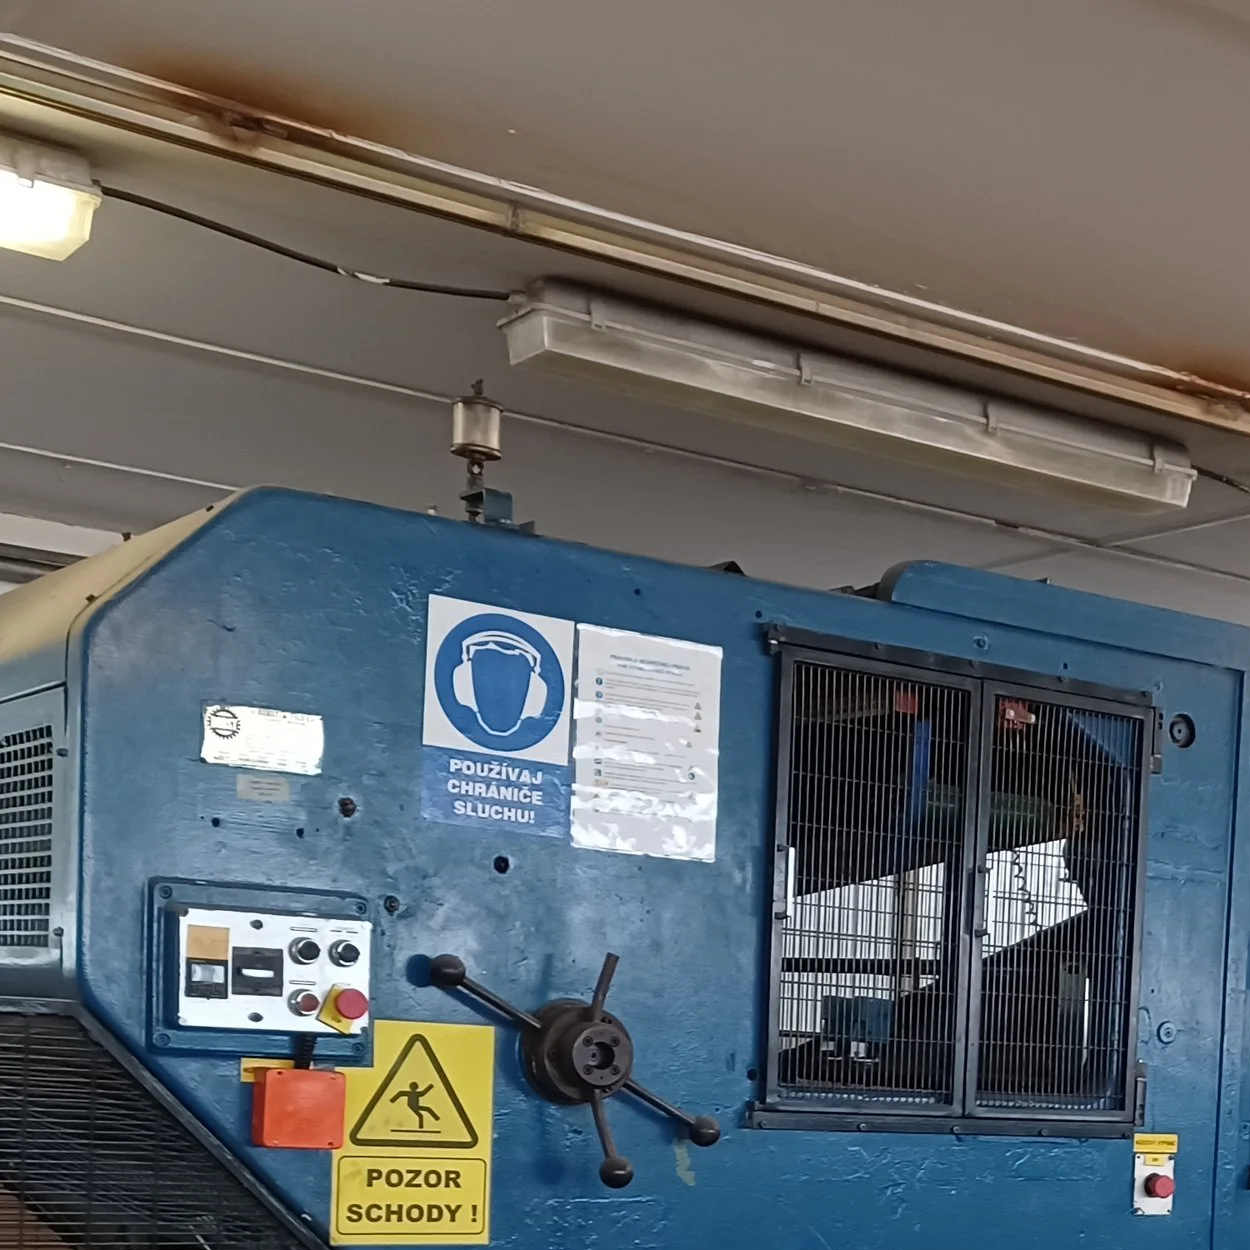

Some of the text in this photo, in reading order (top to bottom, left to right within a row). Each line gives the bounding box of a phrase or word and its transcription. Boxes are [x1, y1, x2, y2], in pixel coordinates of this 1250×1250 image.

[449, 758, 543, 785] POUŽÍVAJ
[447, 779, 543, 805] CHRÁNIČE
[453, 800, 535, 824] SLUCHU!
[366, 1168, 462, 1189] POZOR
[345, 1203, 463, 1224] SCHODY
